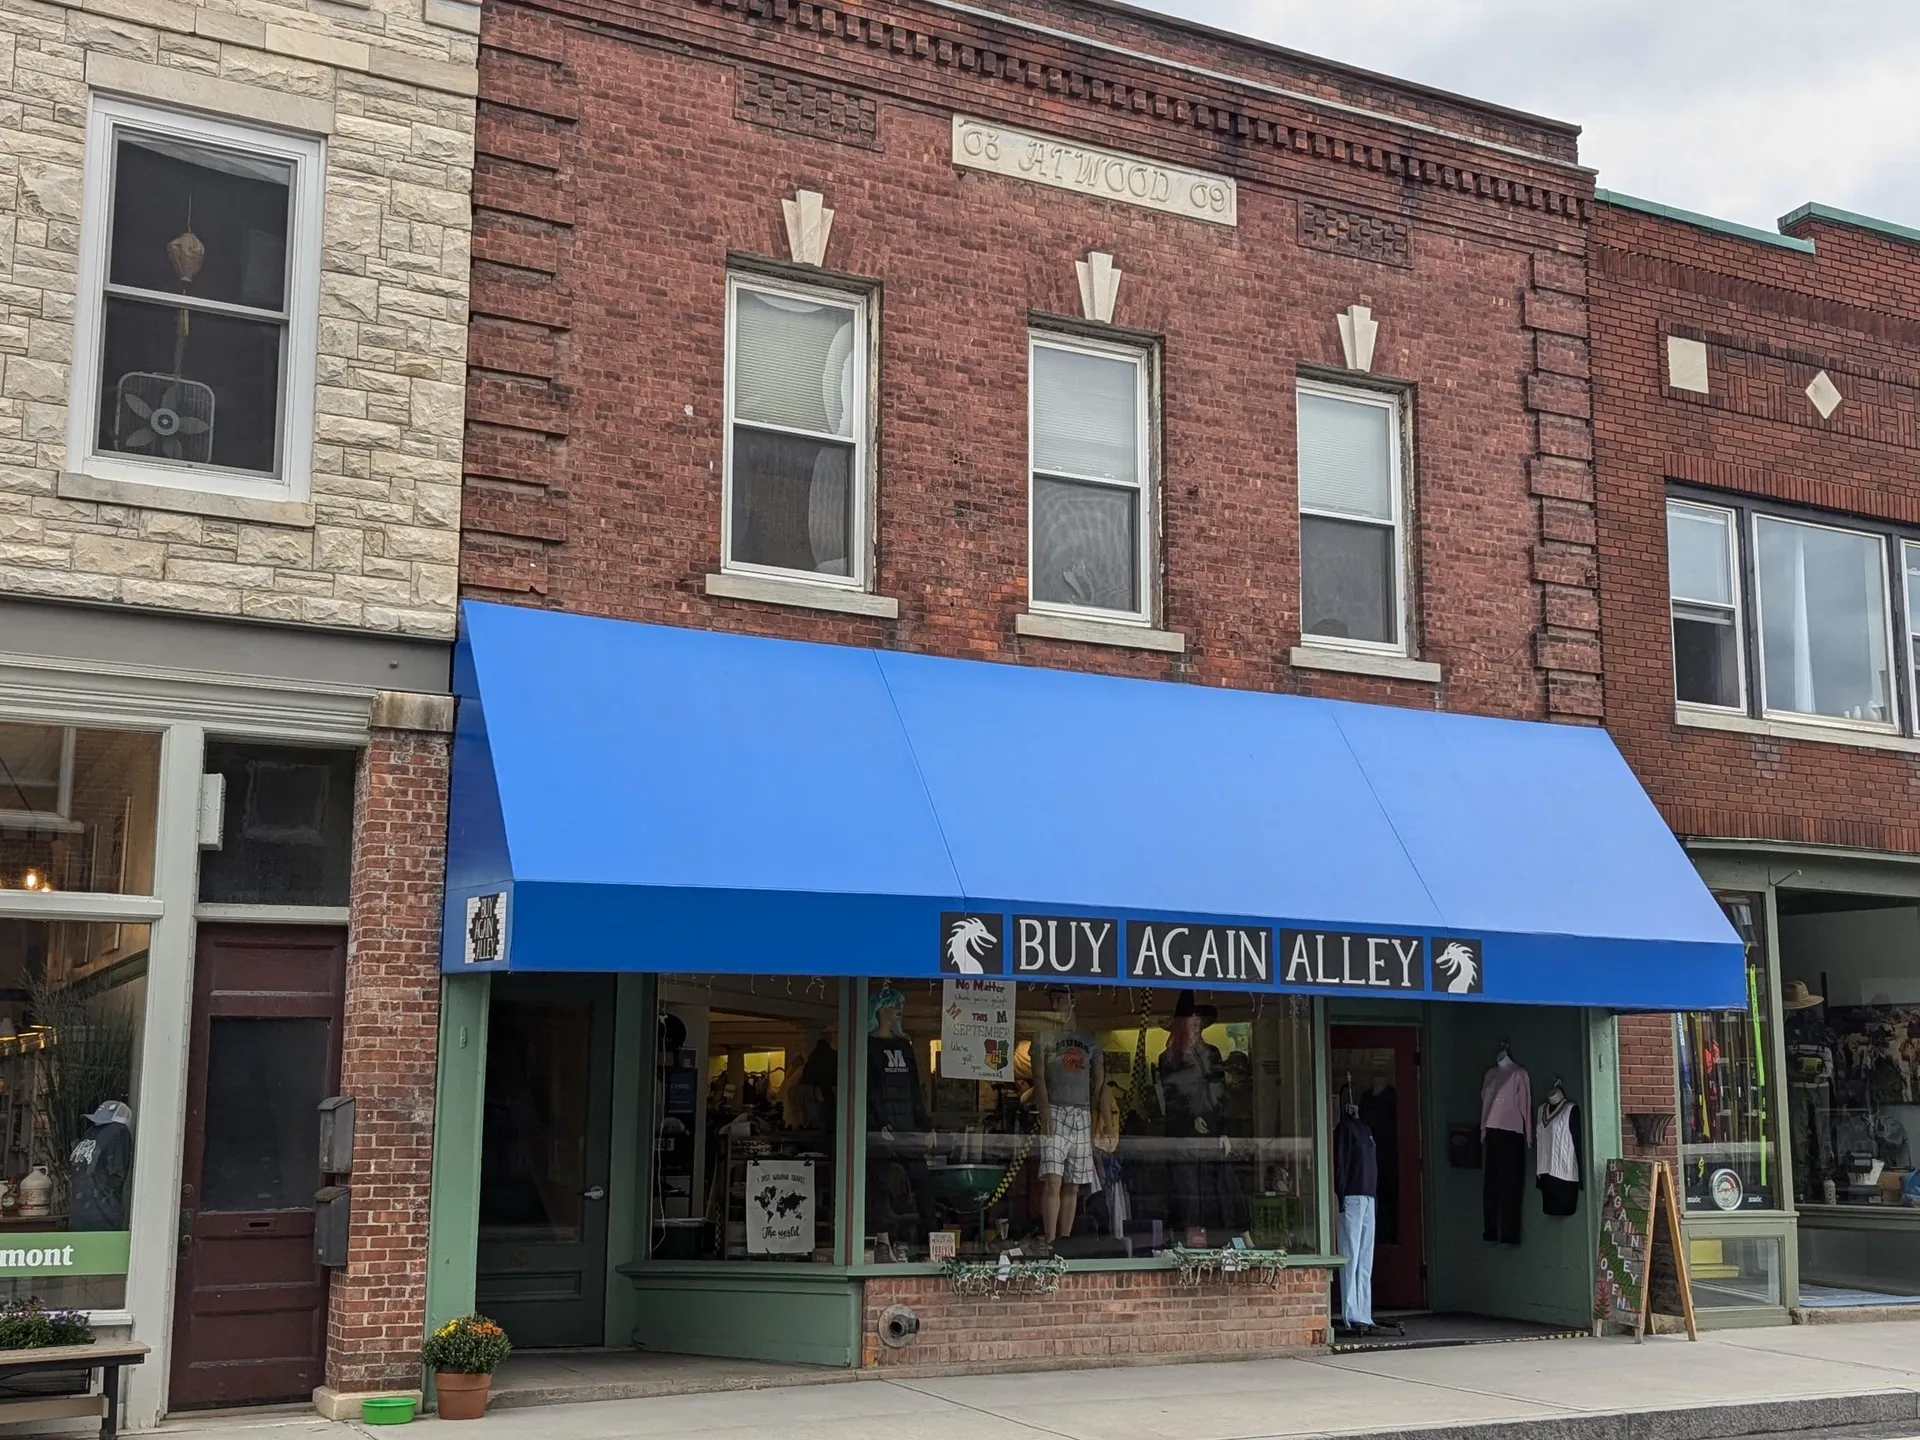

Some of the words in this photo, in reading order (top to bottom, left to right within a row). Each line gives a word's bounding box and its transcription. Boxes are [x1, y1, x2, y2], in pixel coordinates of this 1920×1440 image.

[1018, 139, 1171, 202] ATWOOD
[480, 897, 494, 918] BUY
[474, 917, 494, 940] AGAIN
[475, 937, 496, 960] ALLEY
[1018, 918, 1111, 974] BUY
[1133, 925, 1268, 981] AGAIN
[1285, 933, 1419, 989] ALLEY
[955, 979, 970, 990] No
[973, 979, 1005, 993] Matter
[972, 1012, 988, 1022] THIS
[953, 1023, 1010, 1040] SEPTEMBER
[883, 1049, 907, 1068] M
[1610, 1161, 1631, 1197] BUY
[1607, 1183, 1640, 1247] AGAIN
[762, 1226, 776, 1239] The
[778, 1225, 800, 1239] world
[1604, 1220, 1638, 1285] ALLEY
[1601, 1257, 1626, 1310] OPEN
